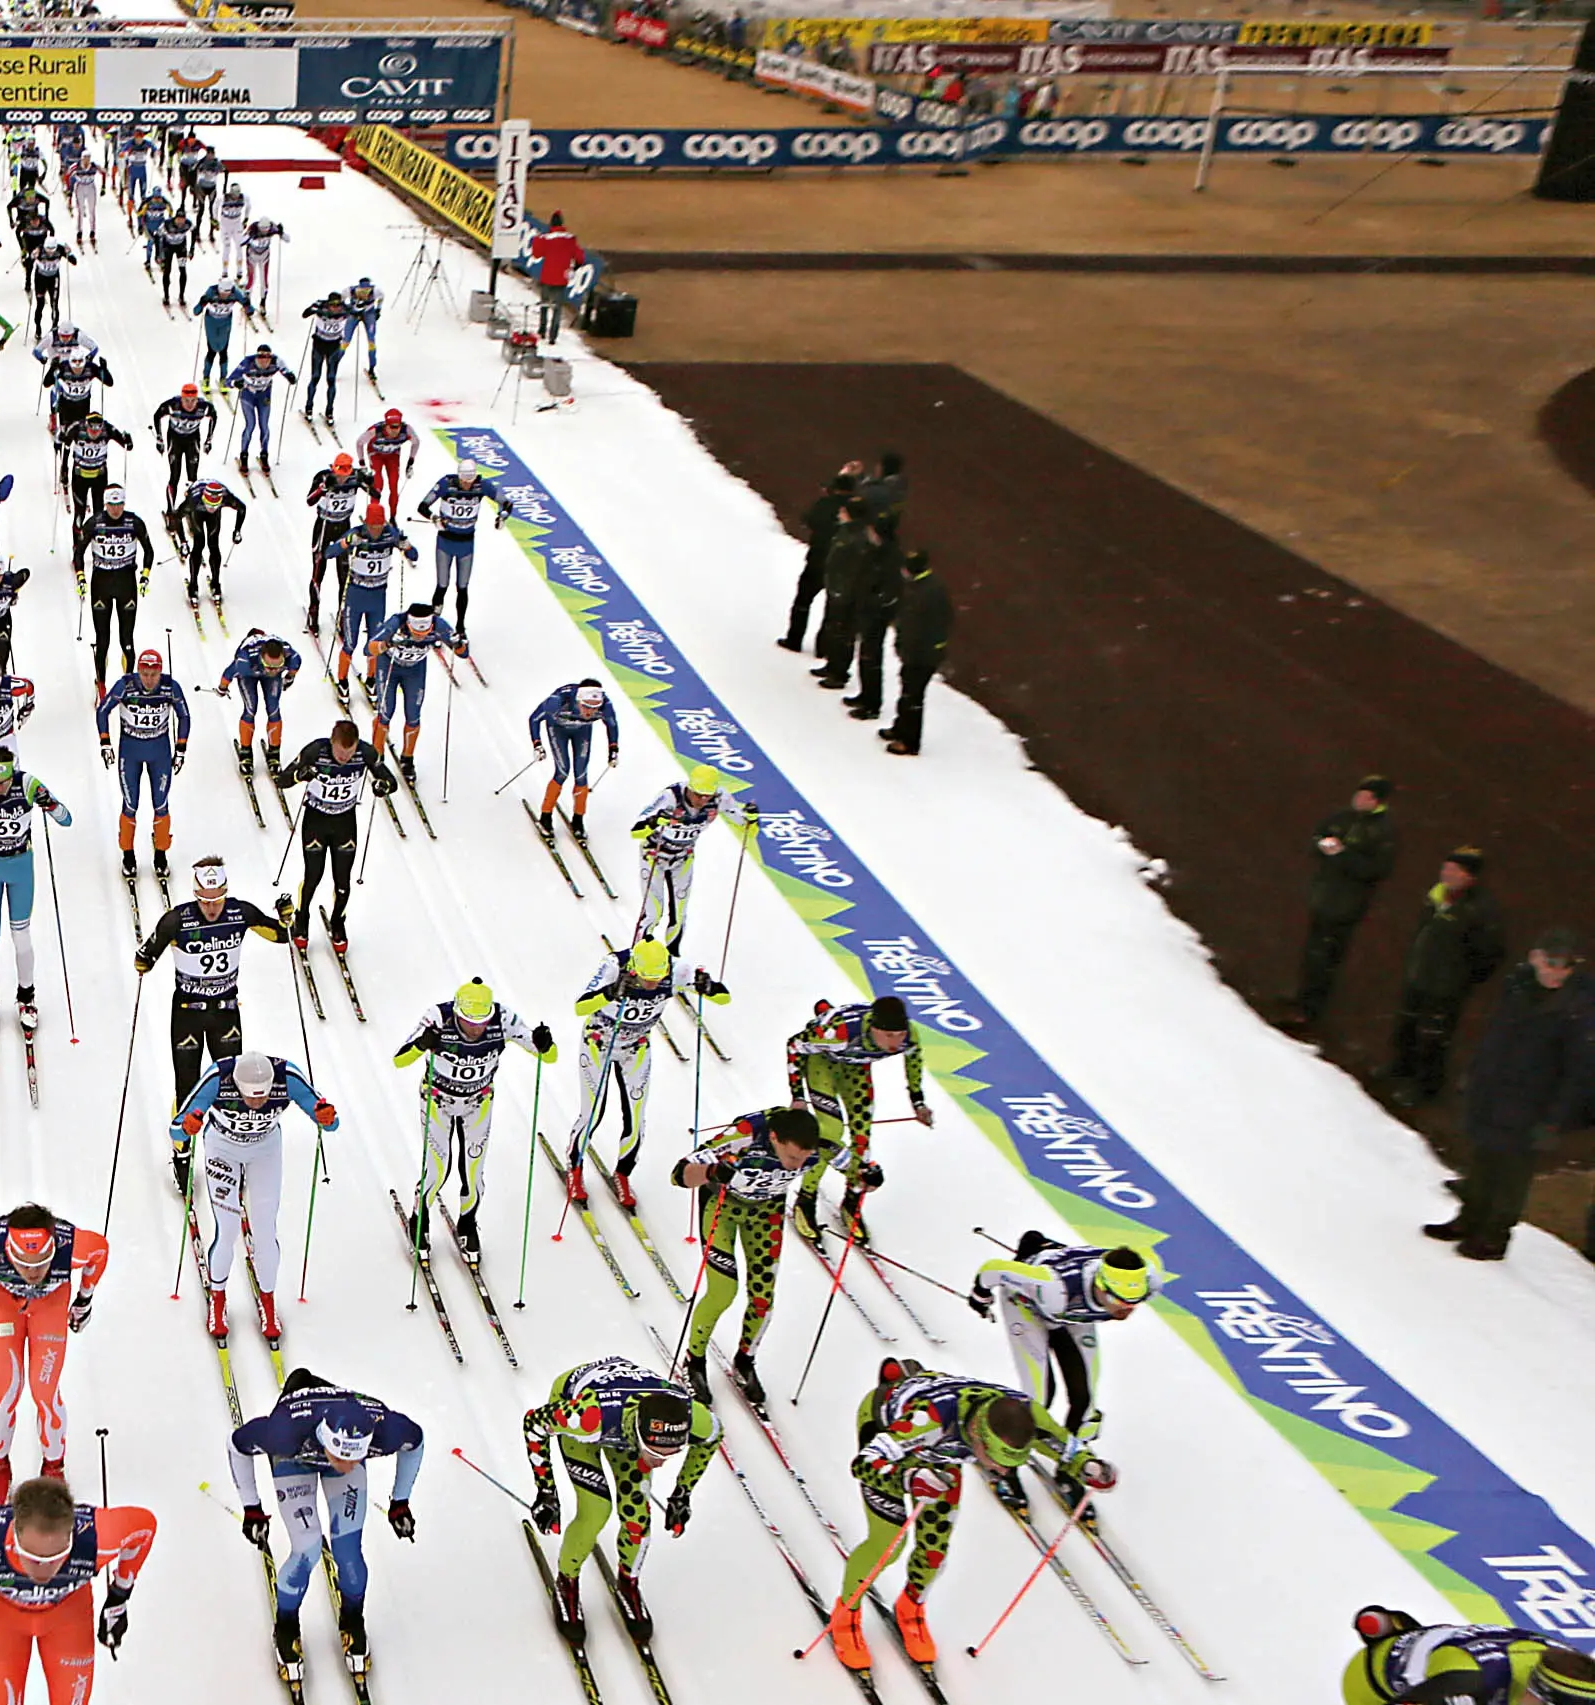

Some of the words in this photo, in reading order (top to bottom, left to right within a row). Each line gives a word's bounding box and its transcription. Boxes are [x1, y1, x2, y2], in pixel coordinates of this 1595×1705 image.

[29, 55, 87, 75] Rurali
[140, 88, 251, 104] TRENTINGRANA
[340, 77, 454, 98] CAVIT
[6, 111, 43, 123] coop
[50, 111, 87, 123] coop
[97, 111, 134, 123] coop
[141, 111, 178, 123] coop
[185, 111, 223, 123] coop
[1020, 121, 1108, 149] coop
[1124, 121, 1213, 149] coop
[1228, 121, 1317, 149] coop
[1332, 121, 1420, 149] coop
[1437, 120, 1523, 151] coop
[455, 134, 550, 160] cop
[570, 134, 664, 164] coop
[684, 134, 777, 164] coop
[793, 133, 881, 162] coop
[500, 135, 521, 230] ITAS
[81, 447, 101, 458] 107
[461, 435, 509, 468] TRENTINO
[332, 499, 348, 511] 92
[450, 505, 473, 517] 109
[502, 485, 556, 525] TRENTINO
[95, 533, 132, 544] Melinda
[99, 544, 126, 556] 143
[367, 560, 382, 573] 91
[551, 545, 611, 594] TRENTINO
[397, 652, 425, 661] 127
[606, 619, 675, 676] TRENTINO
[133, 714, 161, 727] 148
[674, 708, 754, 772] TRENTINO
[317, 771, 361, 785] Melinda
[320, 784, 350, 800] 145
[760, 809, 855, 888] TRENTINO
[186, 932, 242, 953] Melinda
[199, 951, 230, 975] 93
[862, 936, 984, 1032] TRENTINO
[449, 1064, 487, 1080] 101
[220, 1090, 239, 1098] coop
[228, 1120, 272, 1132] 132
[1002, 1092, 1158, 1210] TRENTINO
[208, 1158, 233, 1174] coop
[1196, 1284, 1411, 1439] TRENTINO
